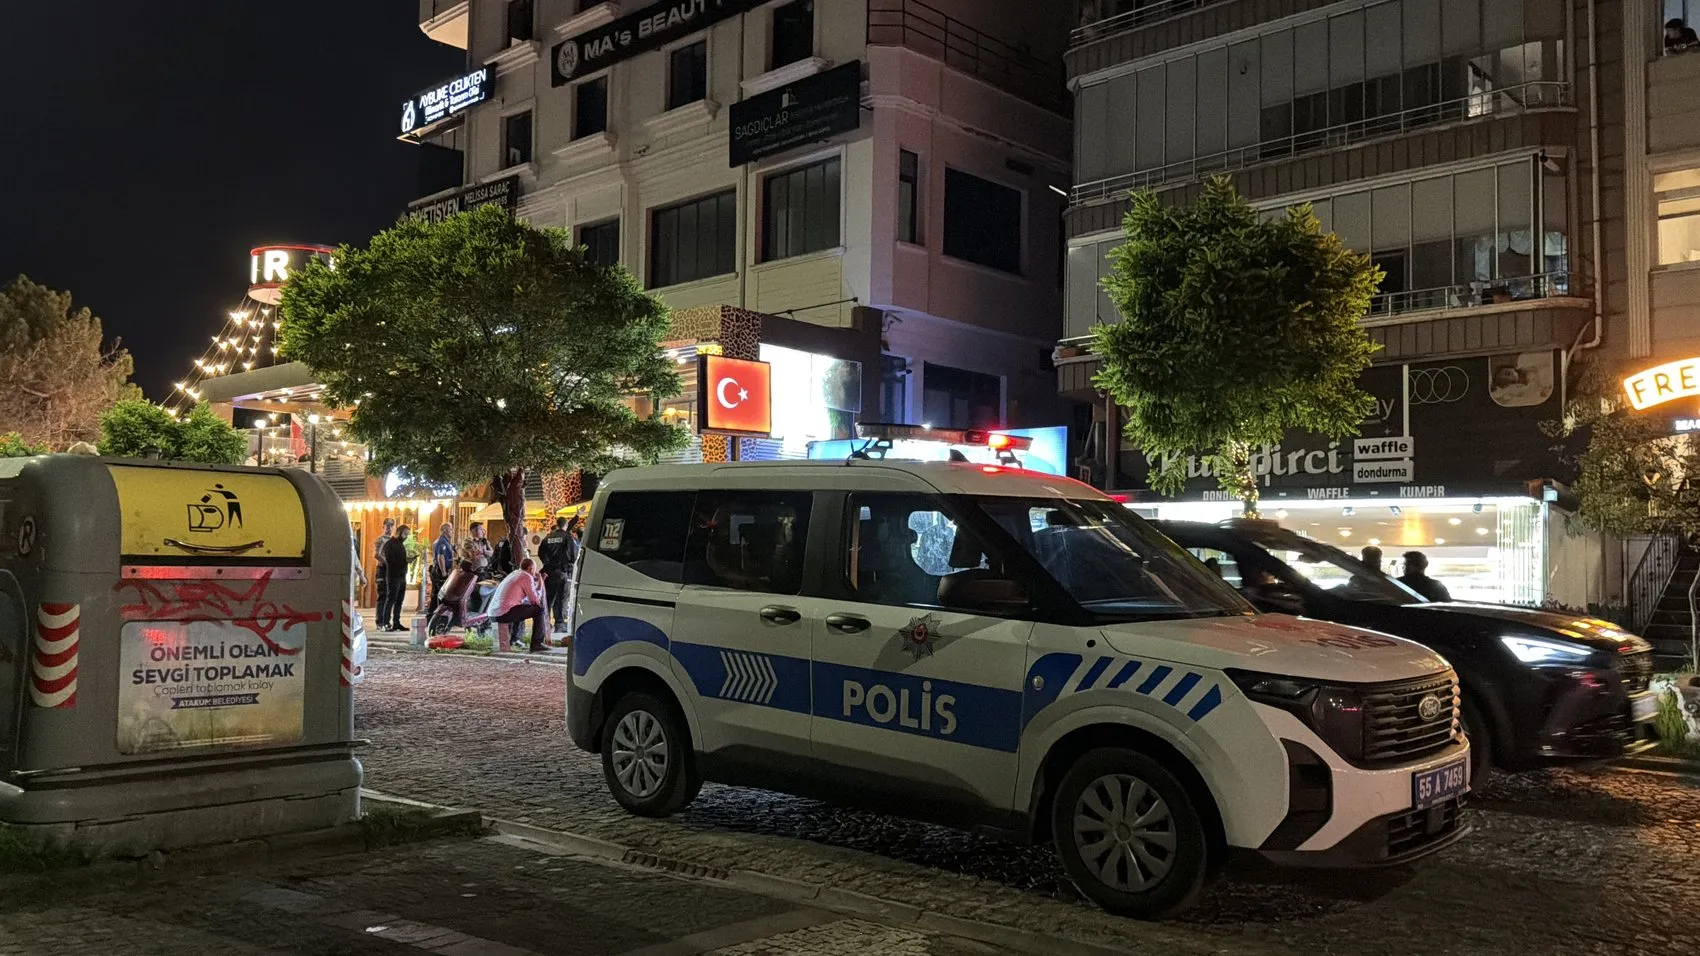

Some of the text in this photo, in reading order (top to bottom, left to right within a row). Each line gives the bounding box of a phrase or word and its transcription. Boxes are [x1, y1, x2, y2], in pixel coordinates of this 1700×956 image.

[637, 0, 723, 38] BEAUT
[1357, 440, 1408, 454] waffle
[1357, 466, 1408, 479] dondurma
[1307, 487, 1350, 499] WAFFLE
[604, 522, 621, 537] 112
[150, 641, 280, 662] ÖNEMLİ OLAN
[132, 663, 294, 685] SEVGİ TOPLAMAK
[196, 681, 246, 696] toplamak
[248, 680, 274, 692] kolay
[179, 698, 212, 707] ATAKUM
[843, 679, 957, 735] POLİS
[1419, 776, 1432, 800] 55
[1434, 773, 1441, 794] A
[1443, 766, 1463, 791] 7459
